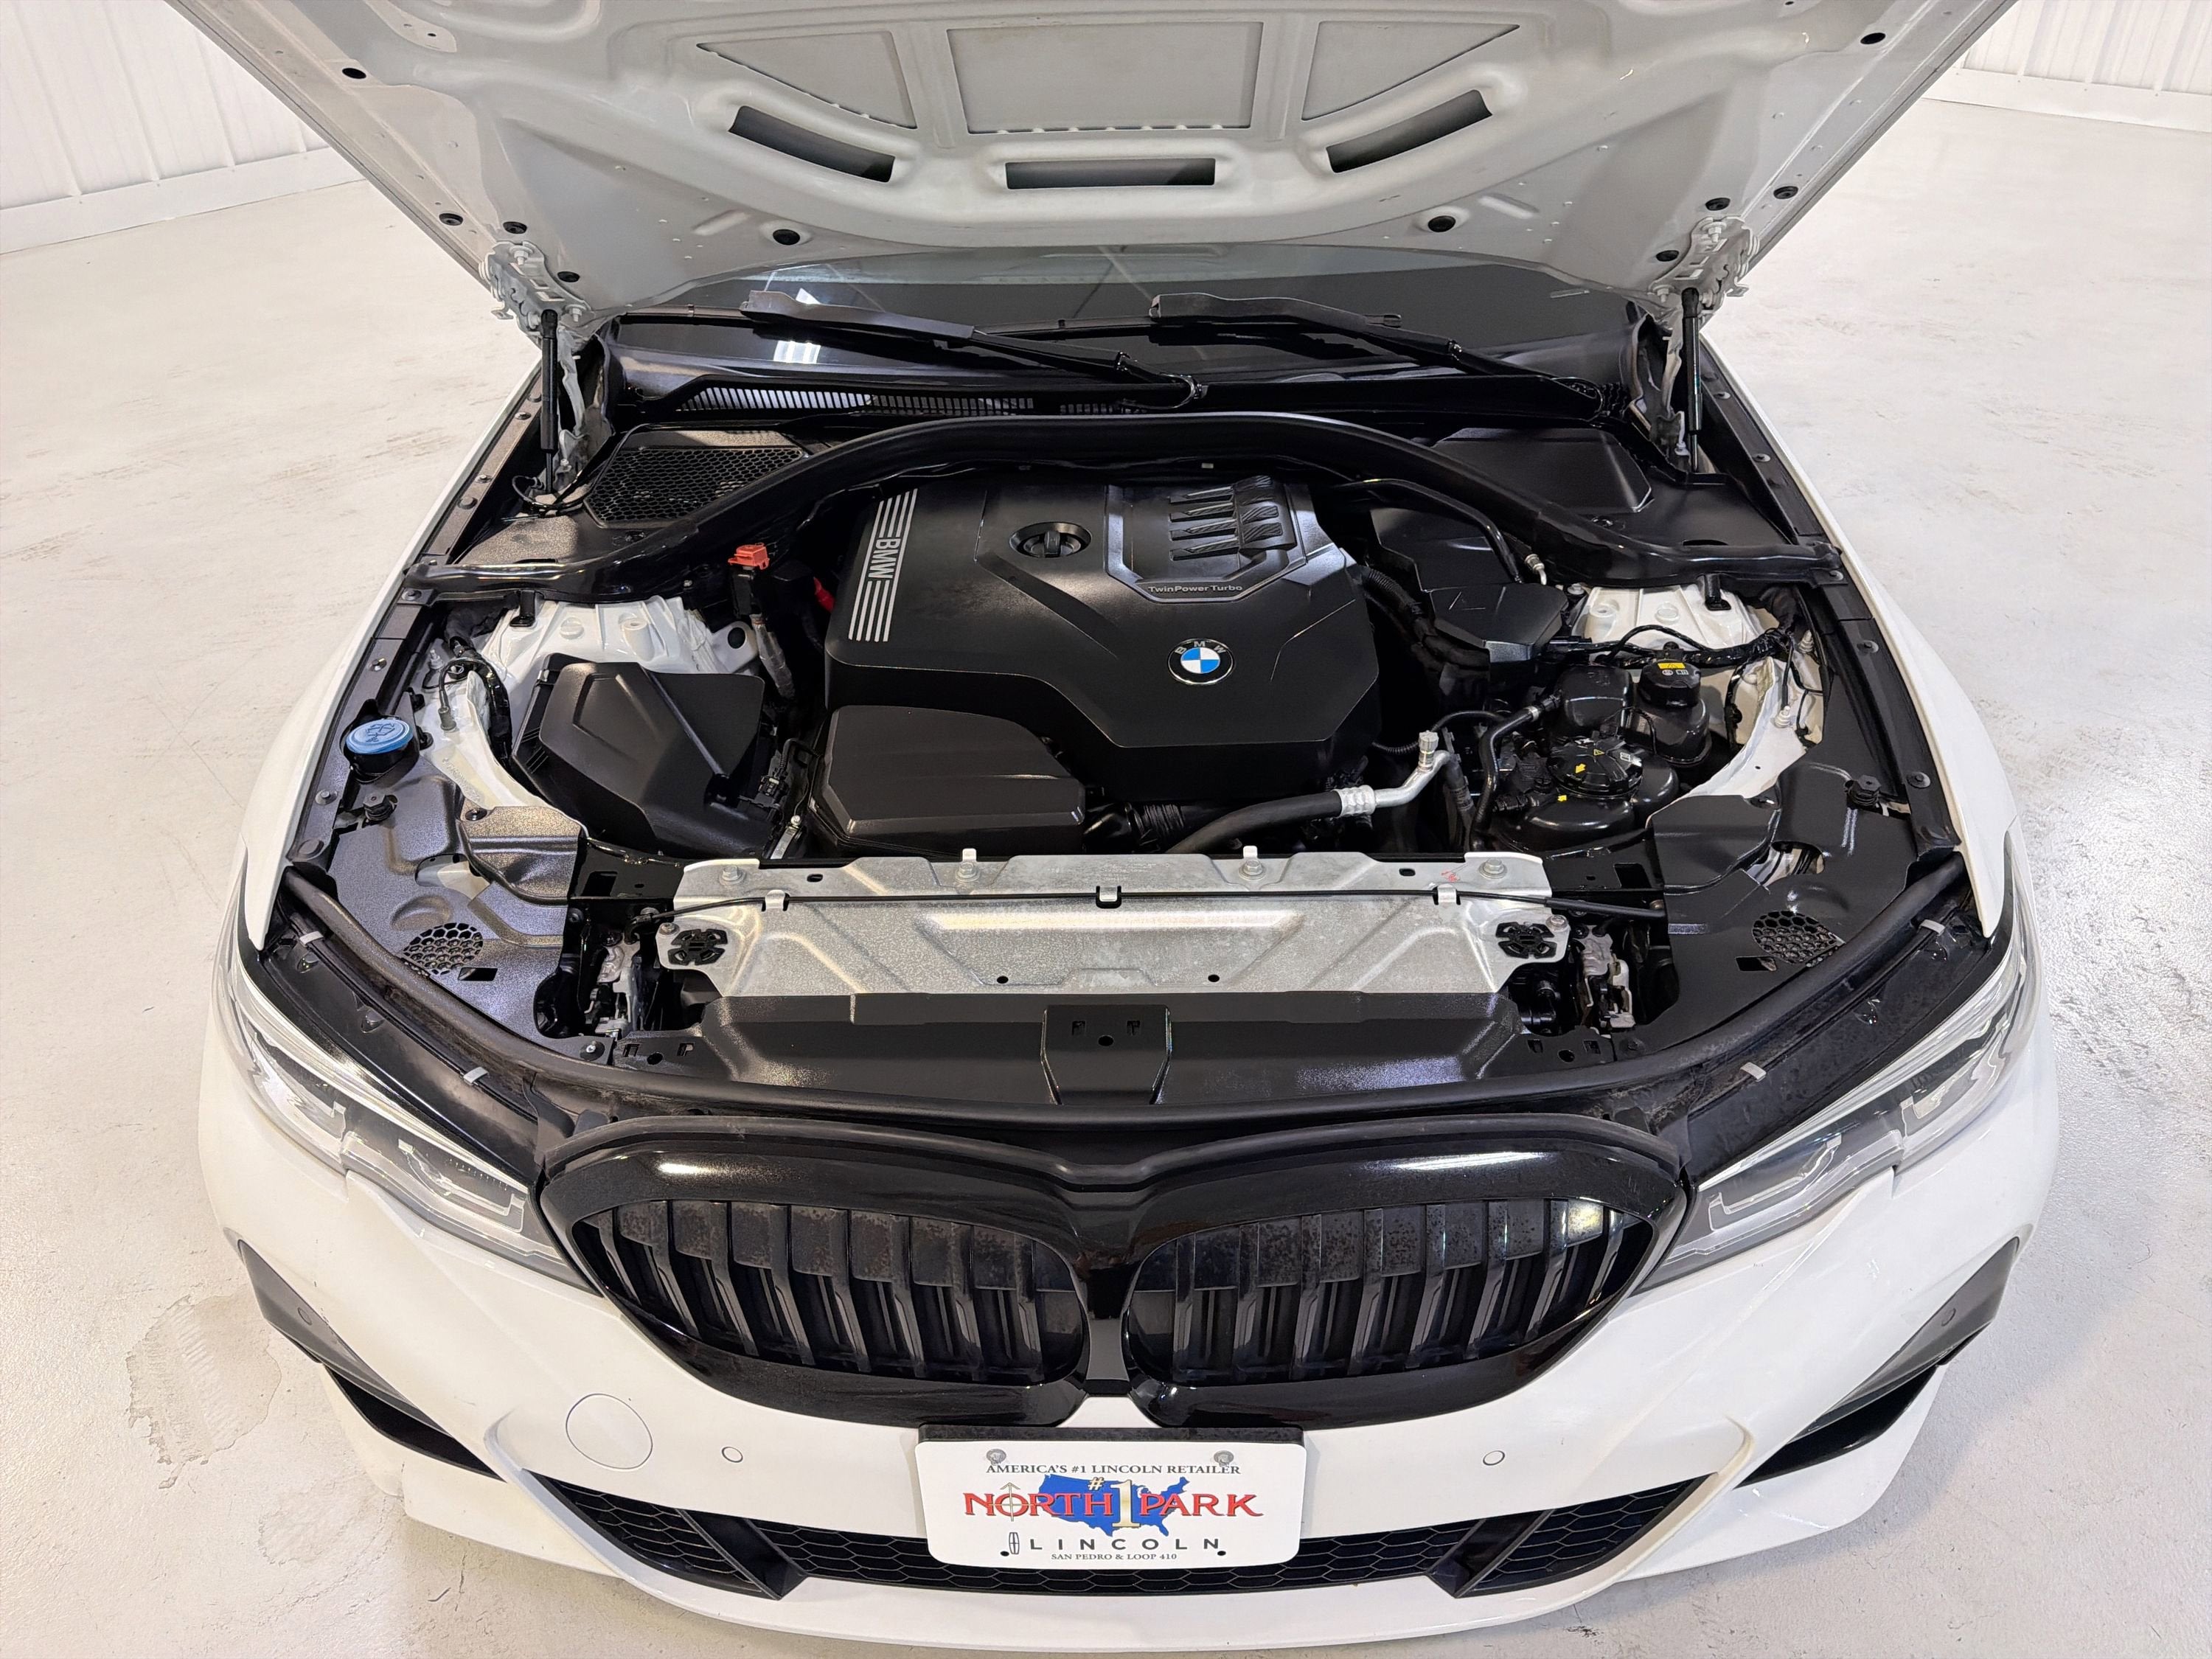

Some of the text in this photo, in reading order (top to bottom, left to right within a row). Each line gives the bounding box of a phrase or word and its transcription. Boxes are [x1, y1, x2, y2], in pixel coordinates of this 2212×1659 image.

[868, 538, 901, 579] BMW
[1175, 641, 1226, 655] BMW
[986, 1465, 1241, 1474] AMERICA'S #1 LINCOLN RETAILER
[963, 1492, 1113, 1517] NORTH
[1140, 1493, 1264, 1517] PARK
[1030, 1539, 1219, 1550] LINCOLN
